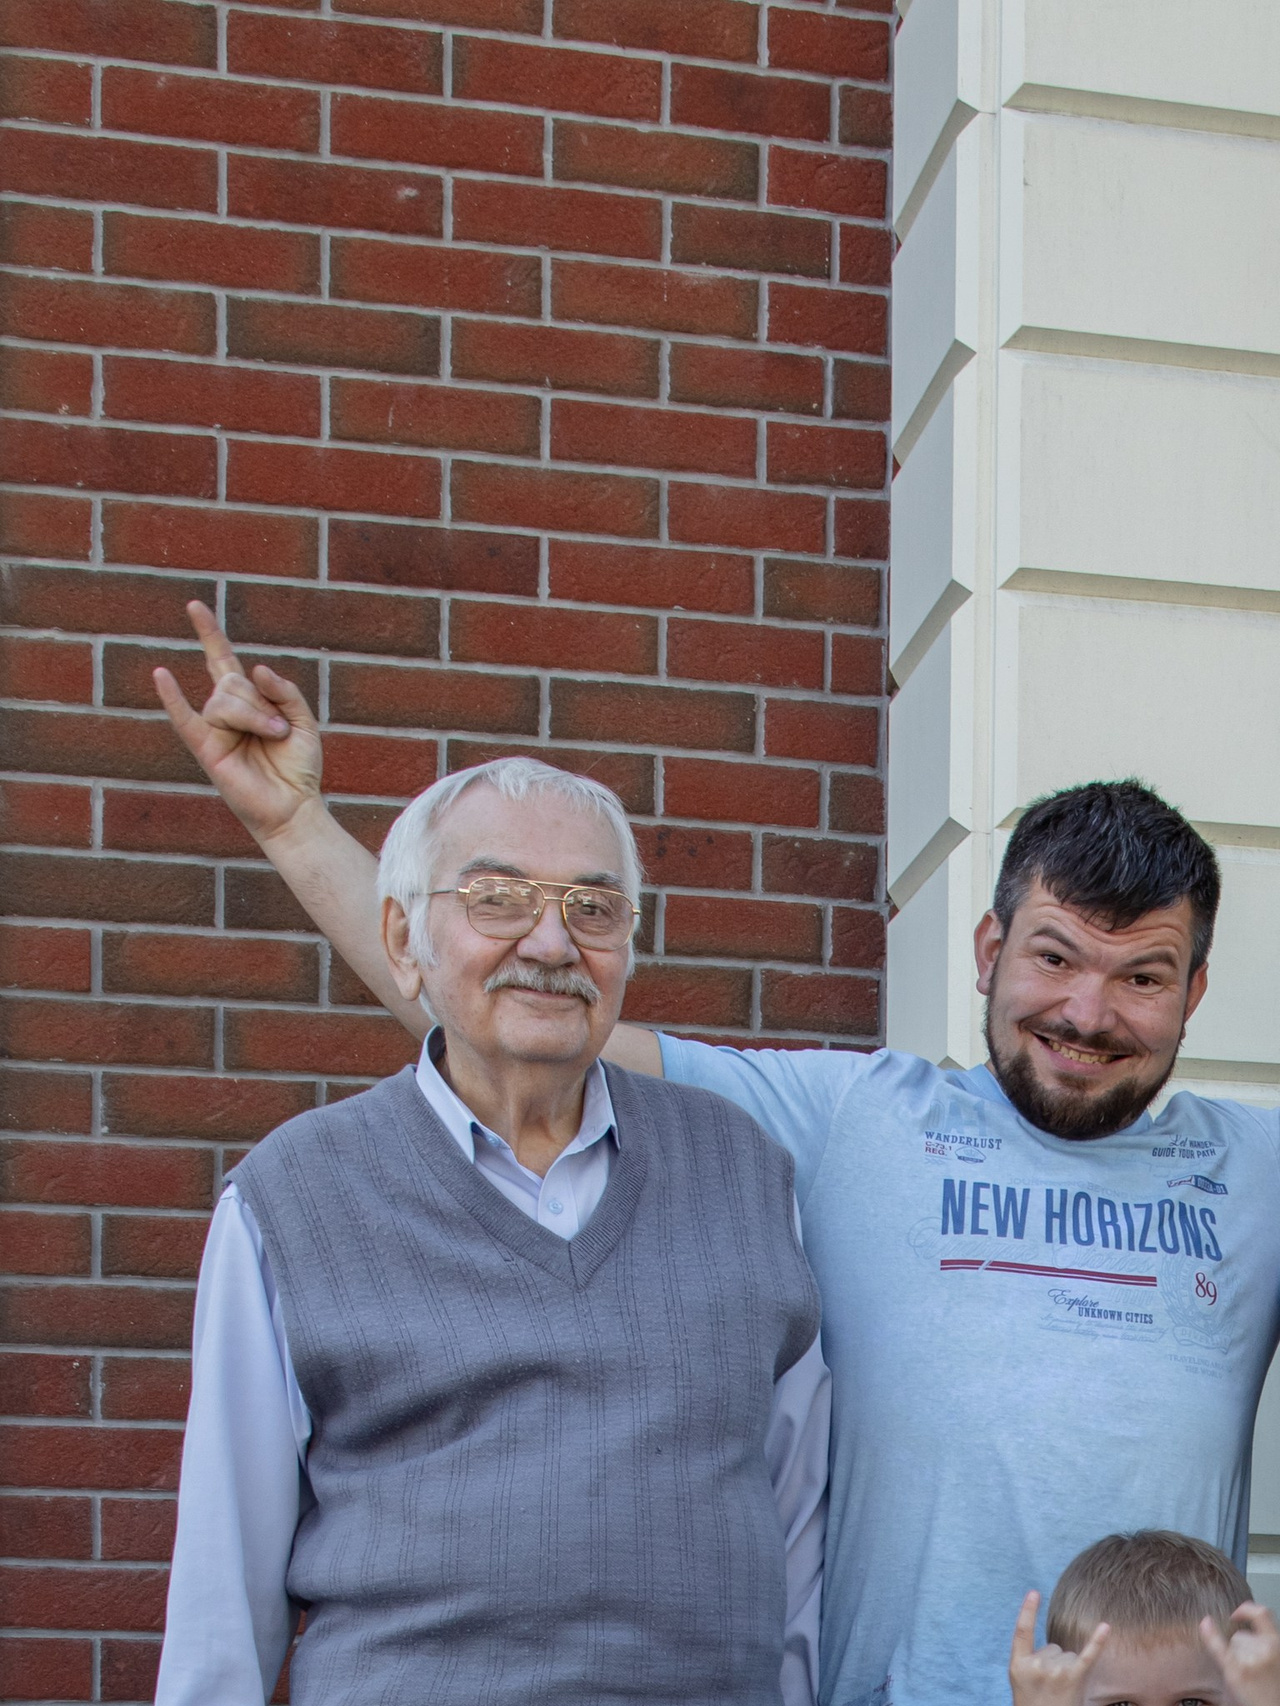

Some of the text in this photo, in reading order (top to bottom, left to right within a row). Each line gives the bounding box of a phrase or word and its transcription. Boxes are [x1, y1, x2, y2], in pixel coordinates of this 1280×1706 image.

[925, 1131, 1002, 1150] WANDERLUST
[1152, 1147, 1217, 1159] GUIDE YOUR PATH
[941, 1179, 1030, 1239] NEW
[1045, 1188, 1222, 1262] HORIZONS
[1047, 1288, 1099, 1311] Explore
[1195, 1272, 1217, 1306] 89
[1078, 1307, 1122, 1321] UNKNOWN
[1125, 1312, 1153, 1325] CITIES
